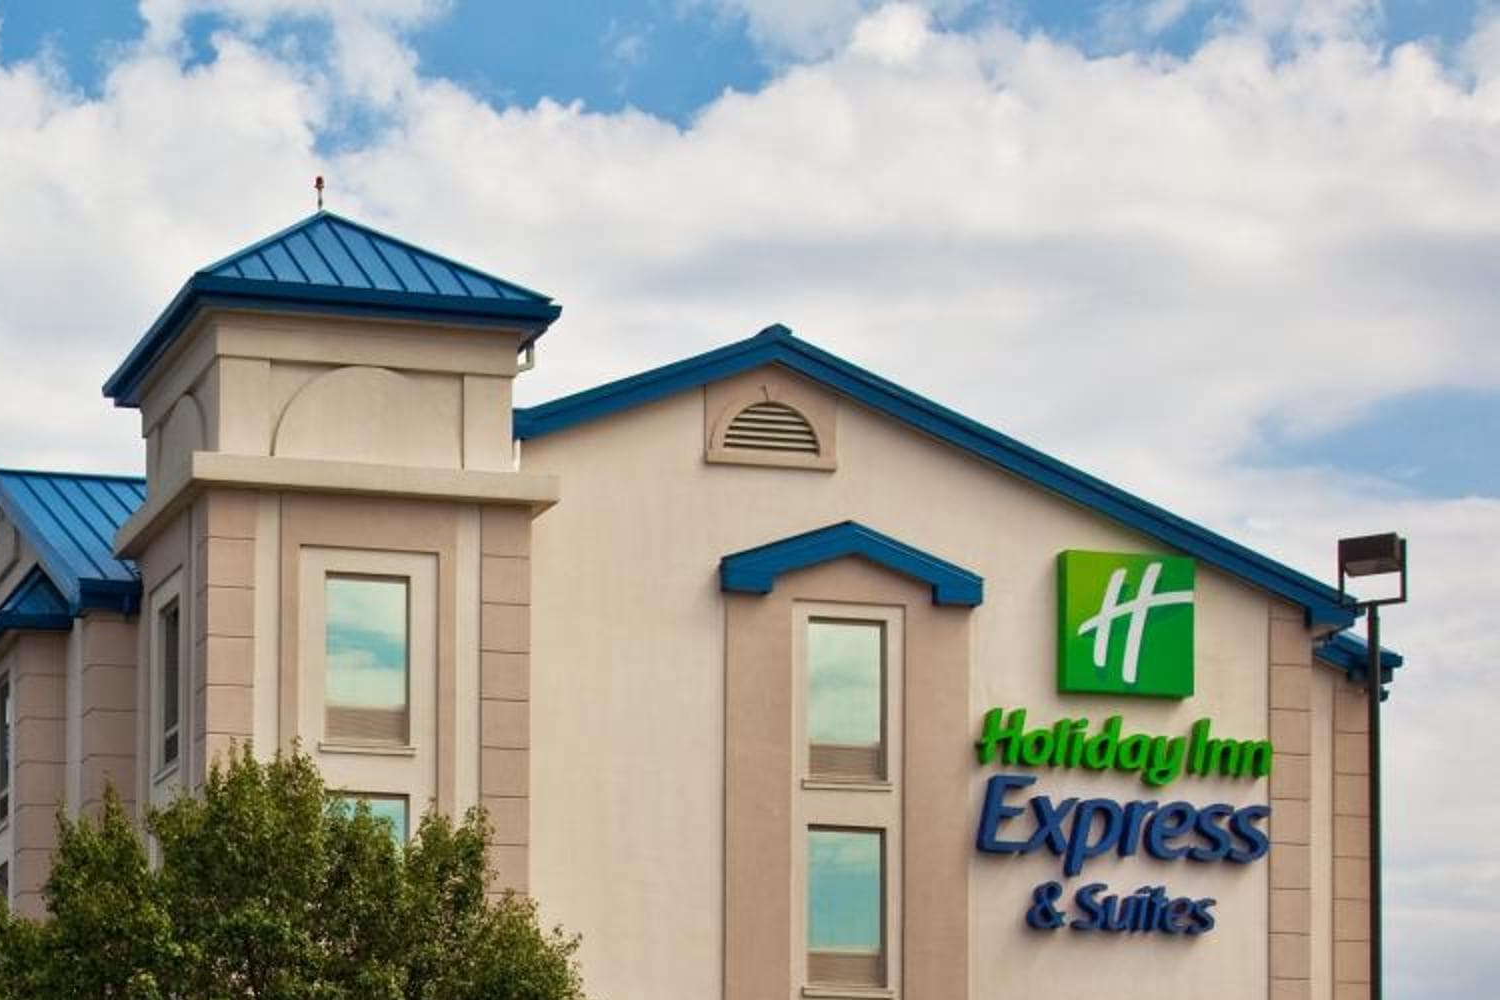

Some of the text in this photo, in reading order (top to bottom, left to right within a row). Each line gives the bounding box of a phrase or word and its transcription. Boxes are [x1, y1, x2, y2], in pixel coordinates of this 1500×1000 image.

[1077, 562, 1195, 683] H
[976, 707, 1273, 787] Holiday Inn
[976, 773, 1272, 878] Express
[1026, 881, 1217, 935] & Suites
